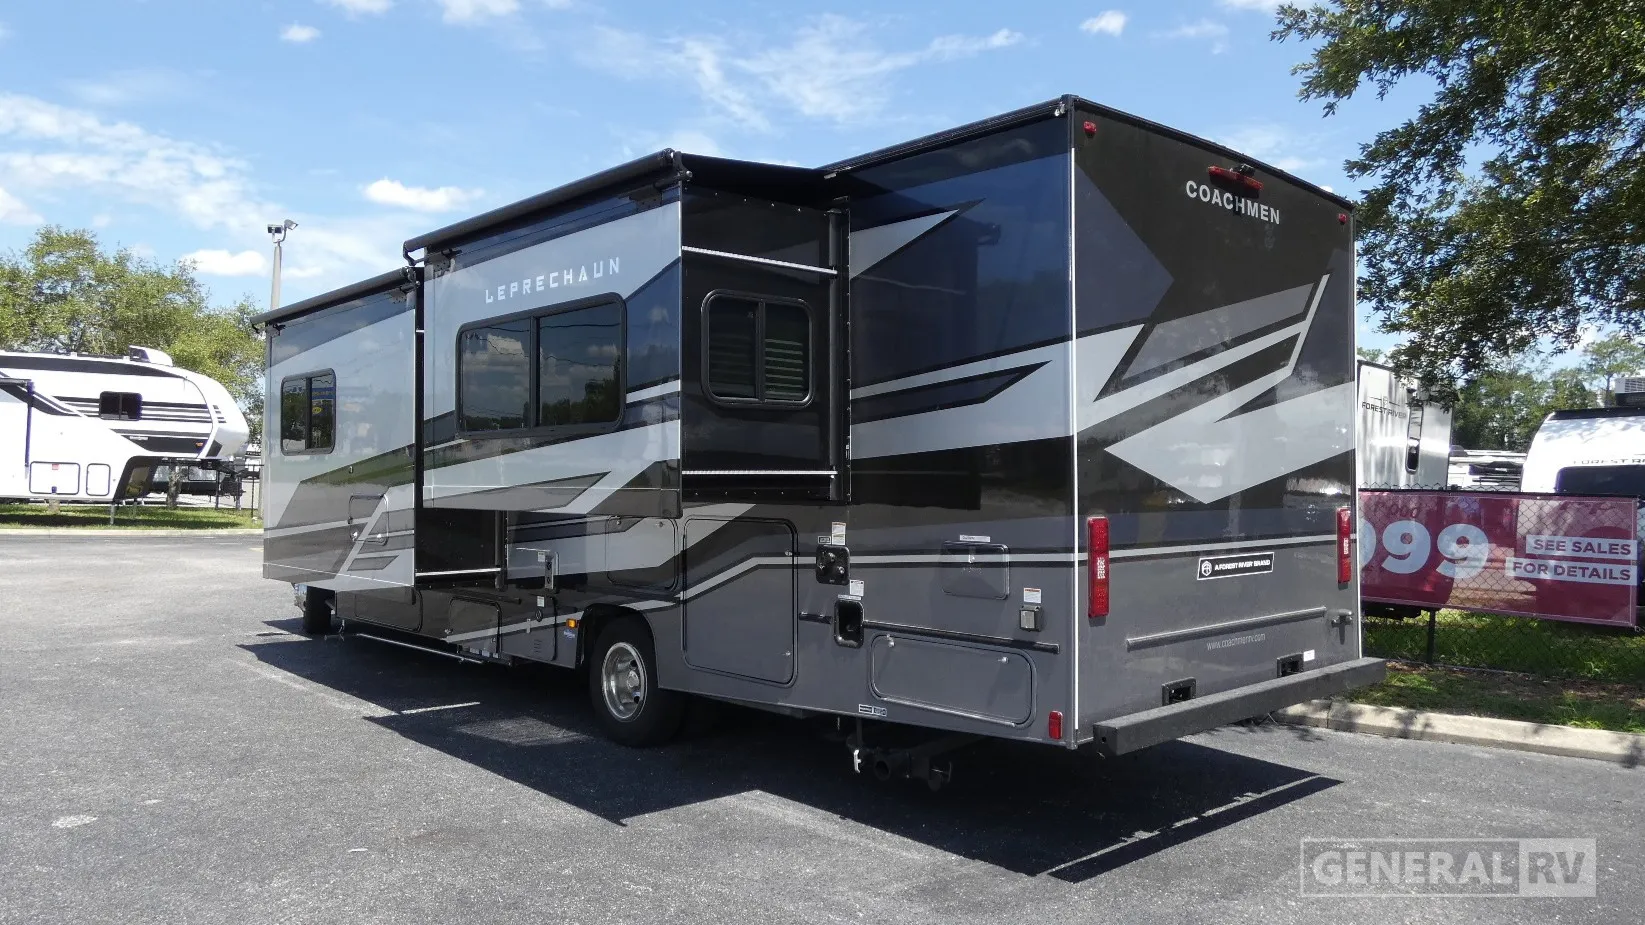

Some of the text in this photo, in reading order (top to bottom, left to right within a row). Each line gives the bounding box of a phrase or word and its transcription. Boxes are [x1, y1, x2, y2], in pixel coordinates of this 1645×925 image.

[1185, 180, 1281, 225] COACHMEN
[485, 256, 621, 304] LEPRECHAUN
[1361, 401, 1387, 415] FOREST
[1532, 539, 1632, 556] SEE SALES
[1512, 561, 1631, 581] FOR DETAILS
